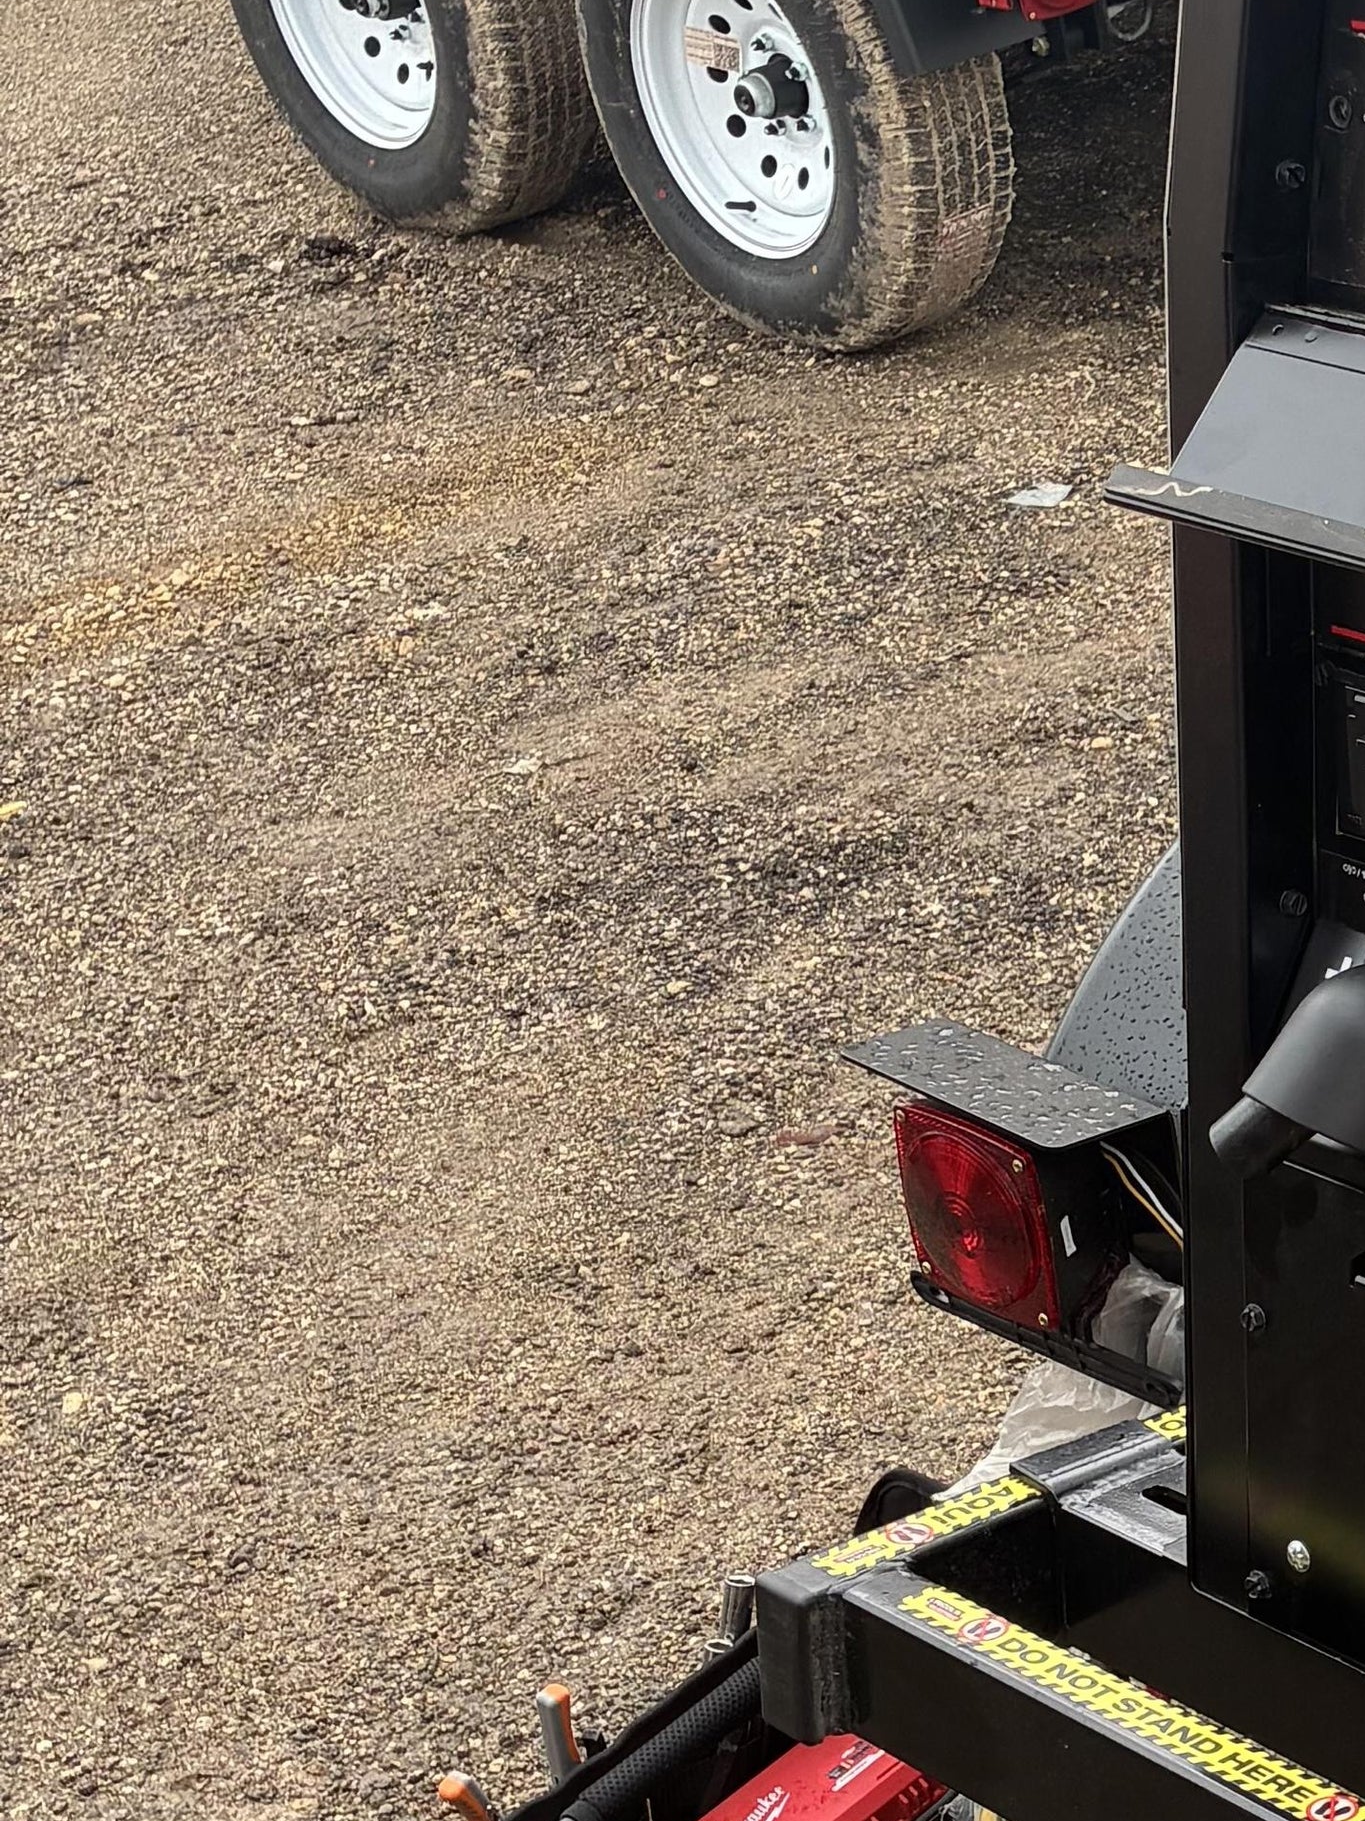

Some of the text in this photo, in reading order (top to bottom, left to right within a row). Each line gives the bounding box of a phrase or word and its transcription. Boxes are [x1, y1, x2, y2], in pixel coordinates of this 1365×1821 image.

[1000, 1637, 1049, 1665] DO
[1045, 1661, 1121, 1699] NOT
[1113, 1697, 1223, 1755] STAND
[1219, 1751, 1318, 1803] HERE
